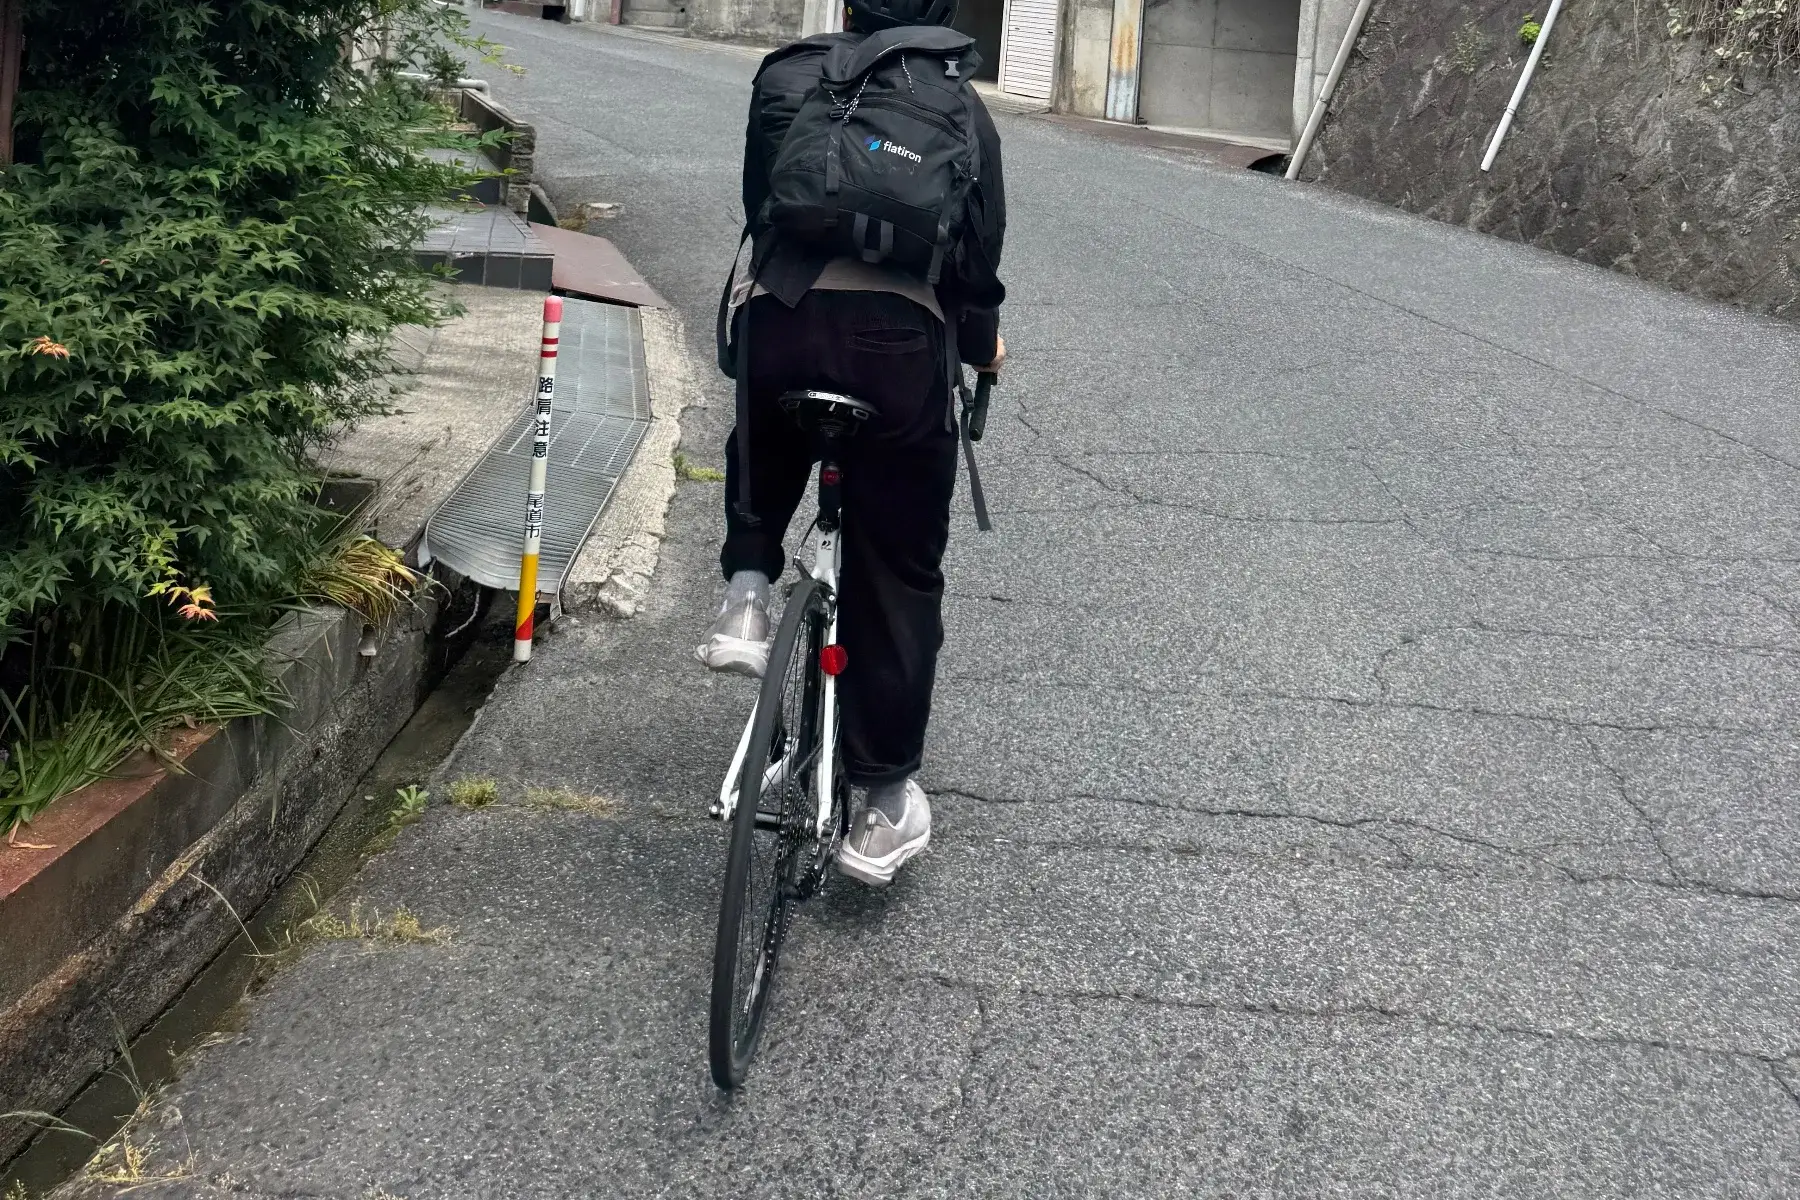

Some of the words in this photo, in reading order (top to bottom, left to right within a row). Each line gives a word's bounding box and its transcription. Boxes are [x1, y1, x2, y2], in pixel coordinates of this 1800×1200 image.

[883, 140, 922, 163] flatiron
[532, 376, 554, 458] 路肩注意
[524, 493, 544, 538] 尾道市
